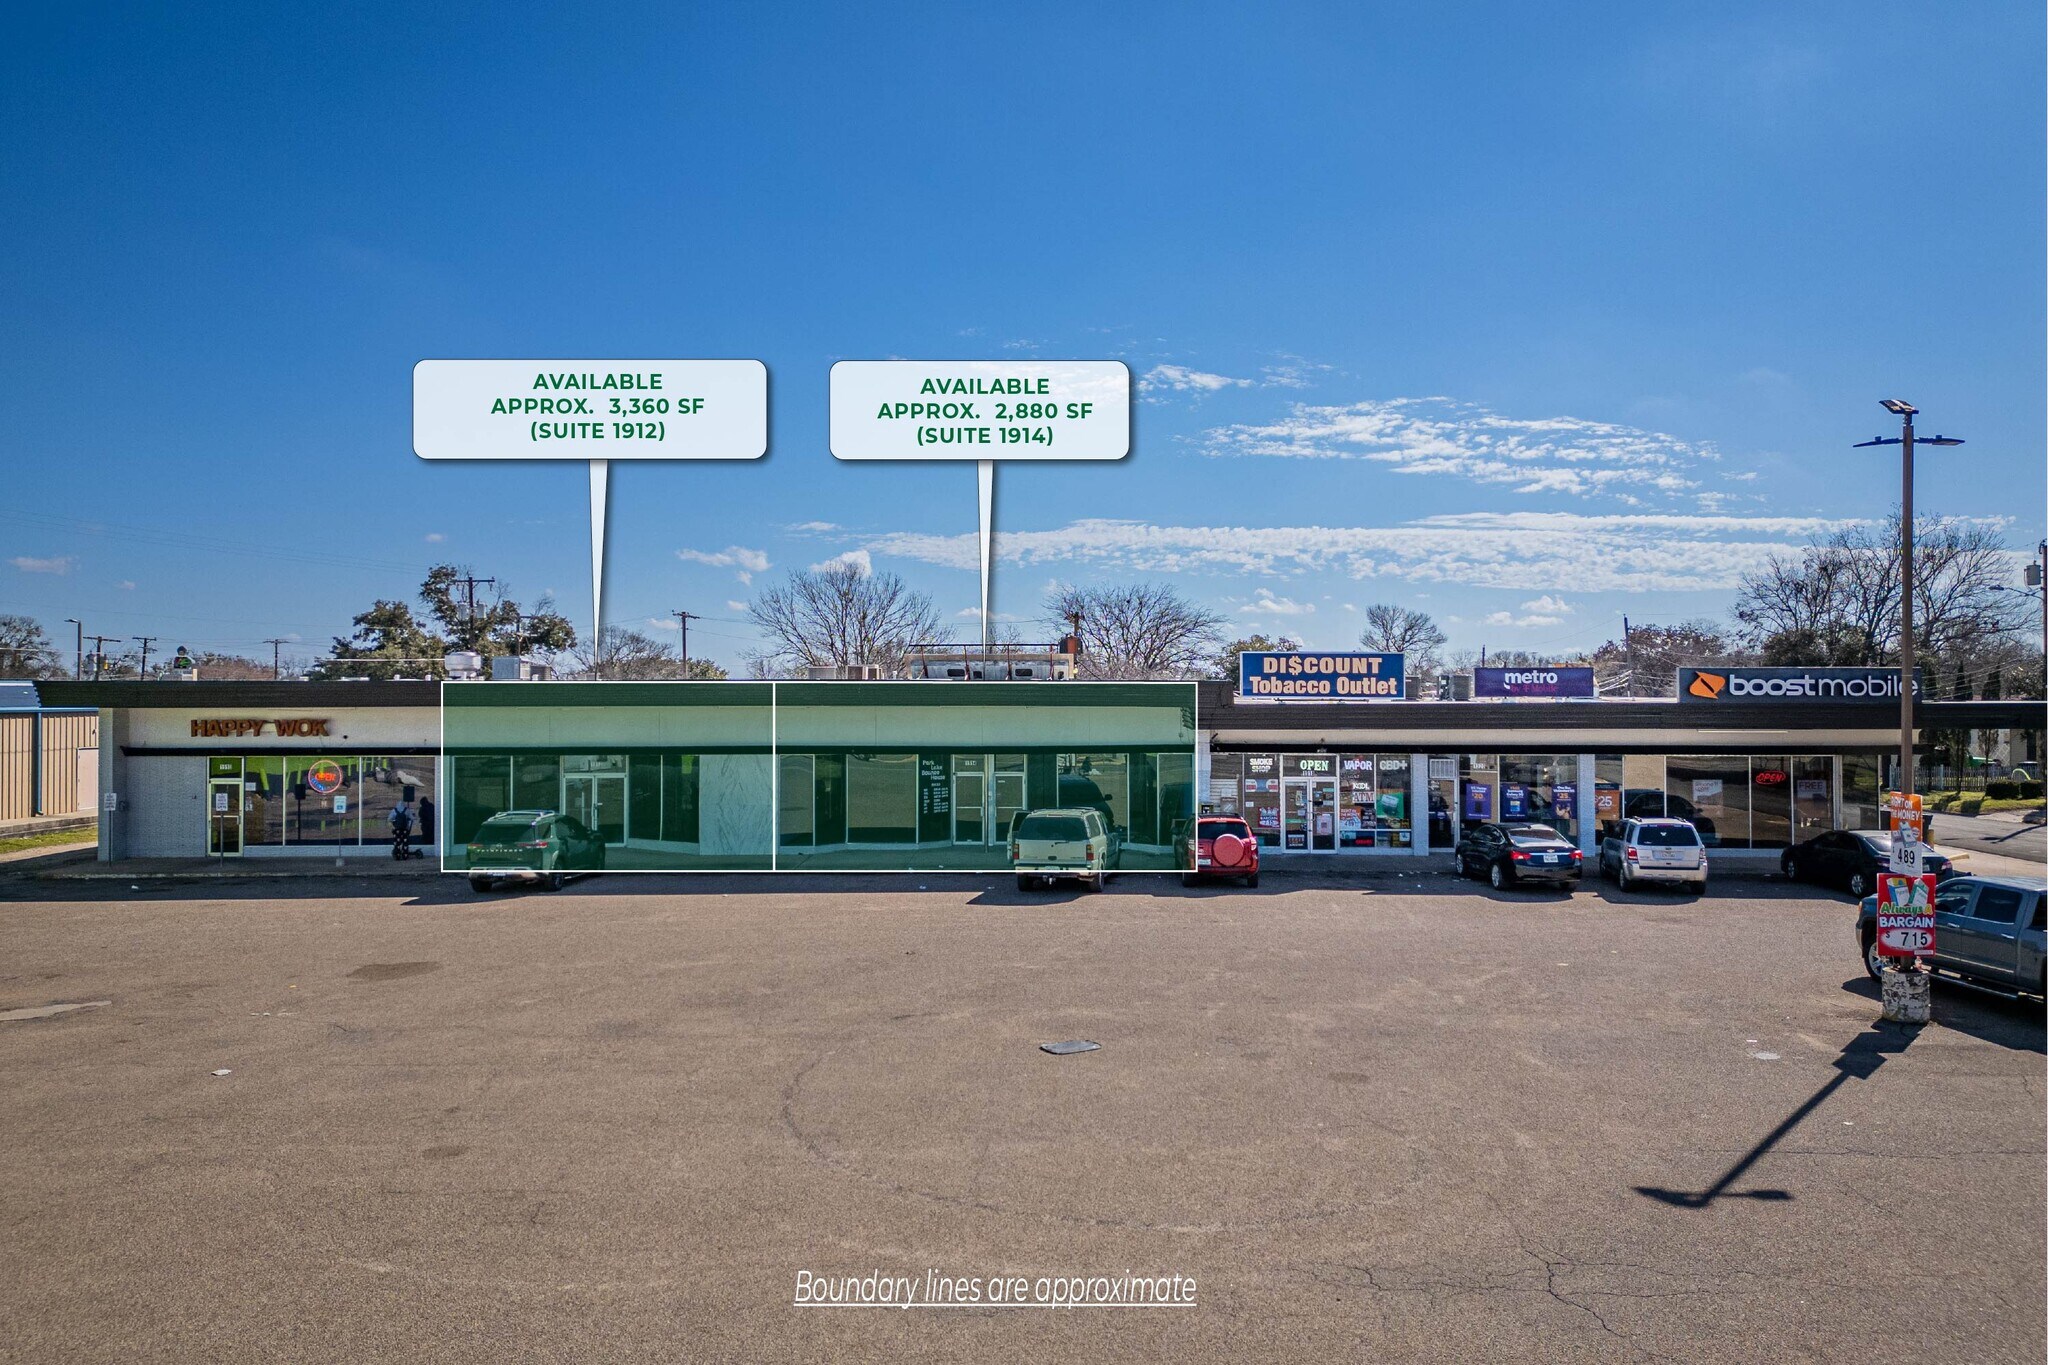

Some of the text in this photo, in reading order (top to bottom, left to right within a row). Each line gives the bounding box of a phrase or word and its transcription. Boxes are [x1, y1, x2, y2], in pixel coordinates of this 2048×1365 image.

[1263, 655, 1383, 675] DI$COUNT
[1504, 669, 1558, 684] metro
[1249, 676, 1398, 695] Tobacco Outlet
[191, 719, 330, 737] HAPPY WOK
[1249, 758, 1273, 766] SMOKE
[1299, 760, 1329, 771] OPEN
[1343, 760, 1372, 771] VAPOR
[1379, 760, 1408, 770] CBD+
[315, 772, 337, 782] OPEN
[1758, 772, 1784, 783] OPEN
[1798, 781, 1823, 790] FREE
[1353, 792, 1374, 802] ATM
[1898, 809, 1921, 821] MONEY
[1897, 848, 1915, 865] 489
[1880, 902, 1933, 917] Always A
[1879, 916, 1934, 928] BARGAIN
[1901, 932, 1928, 946] 715
